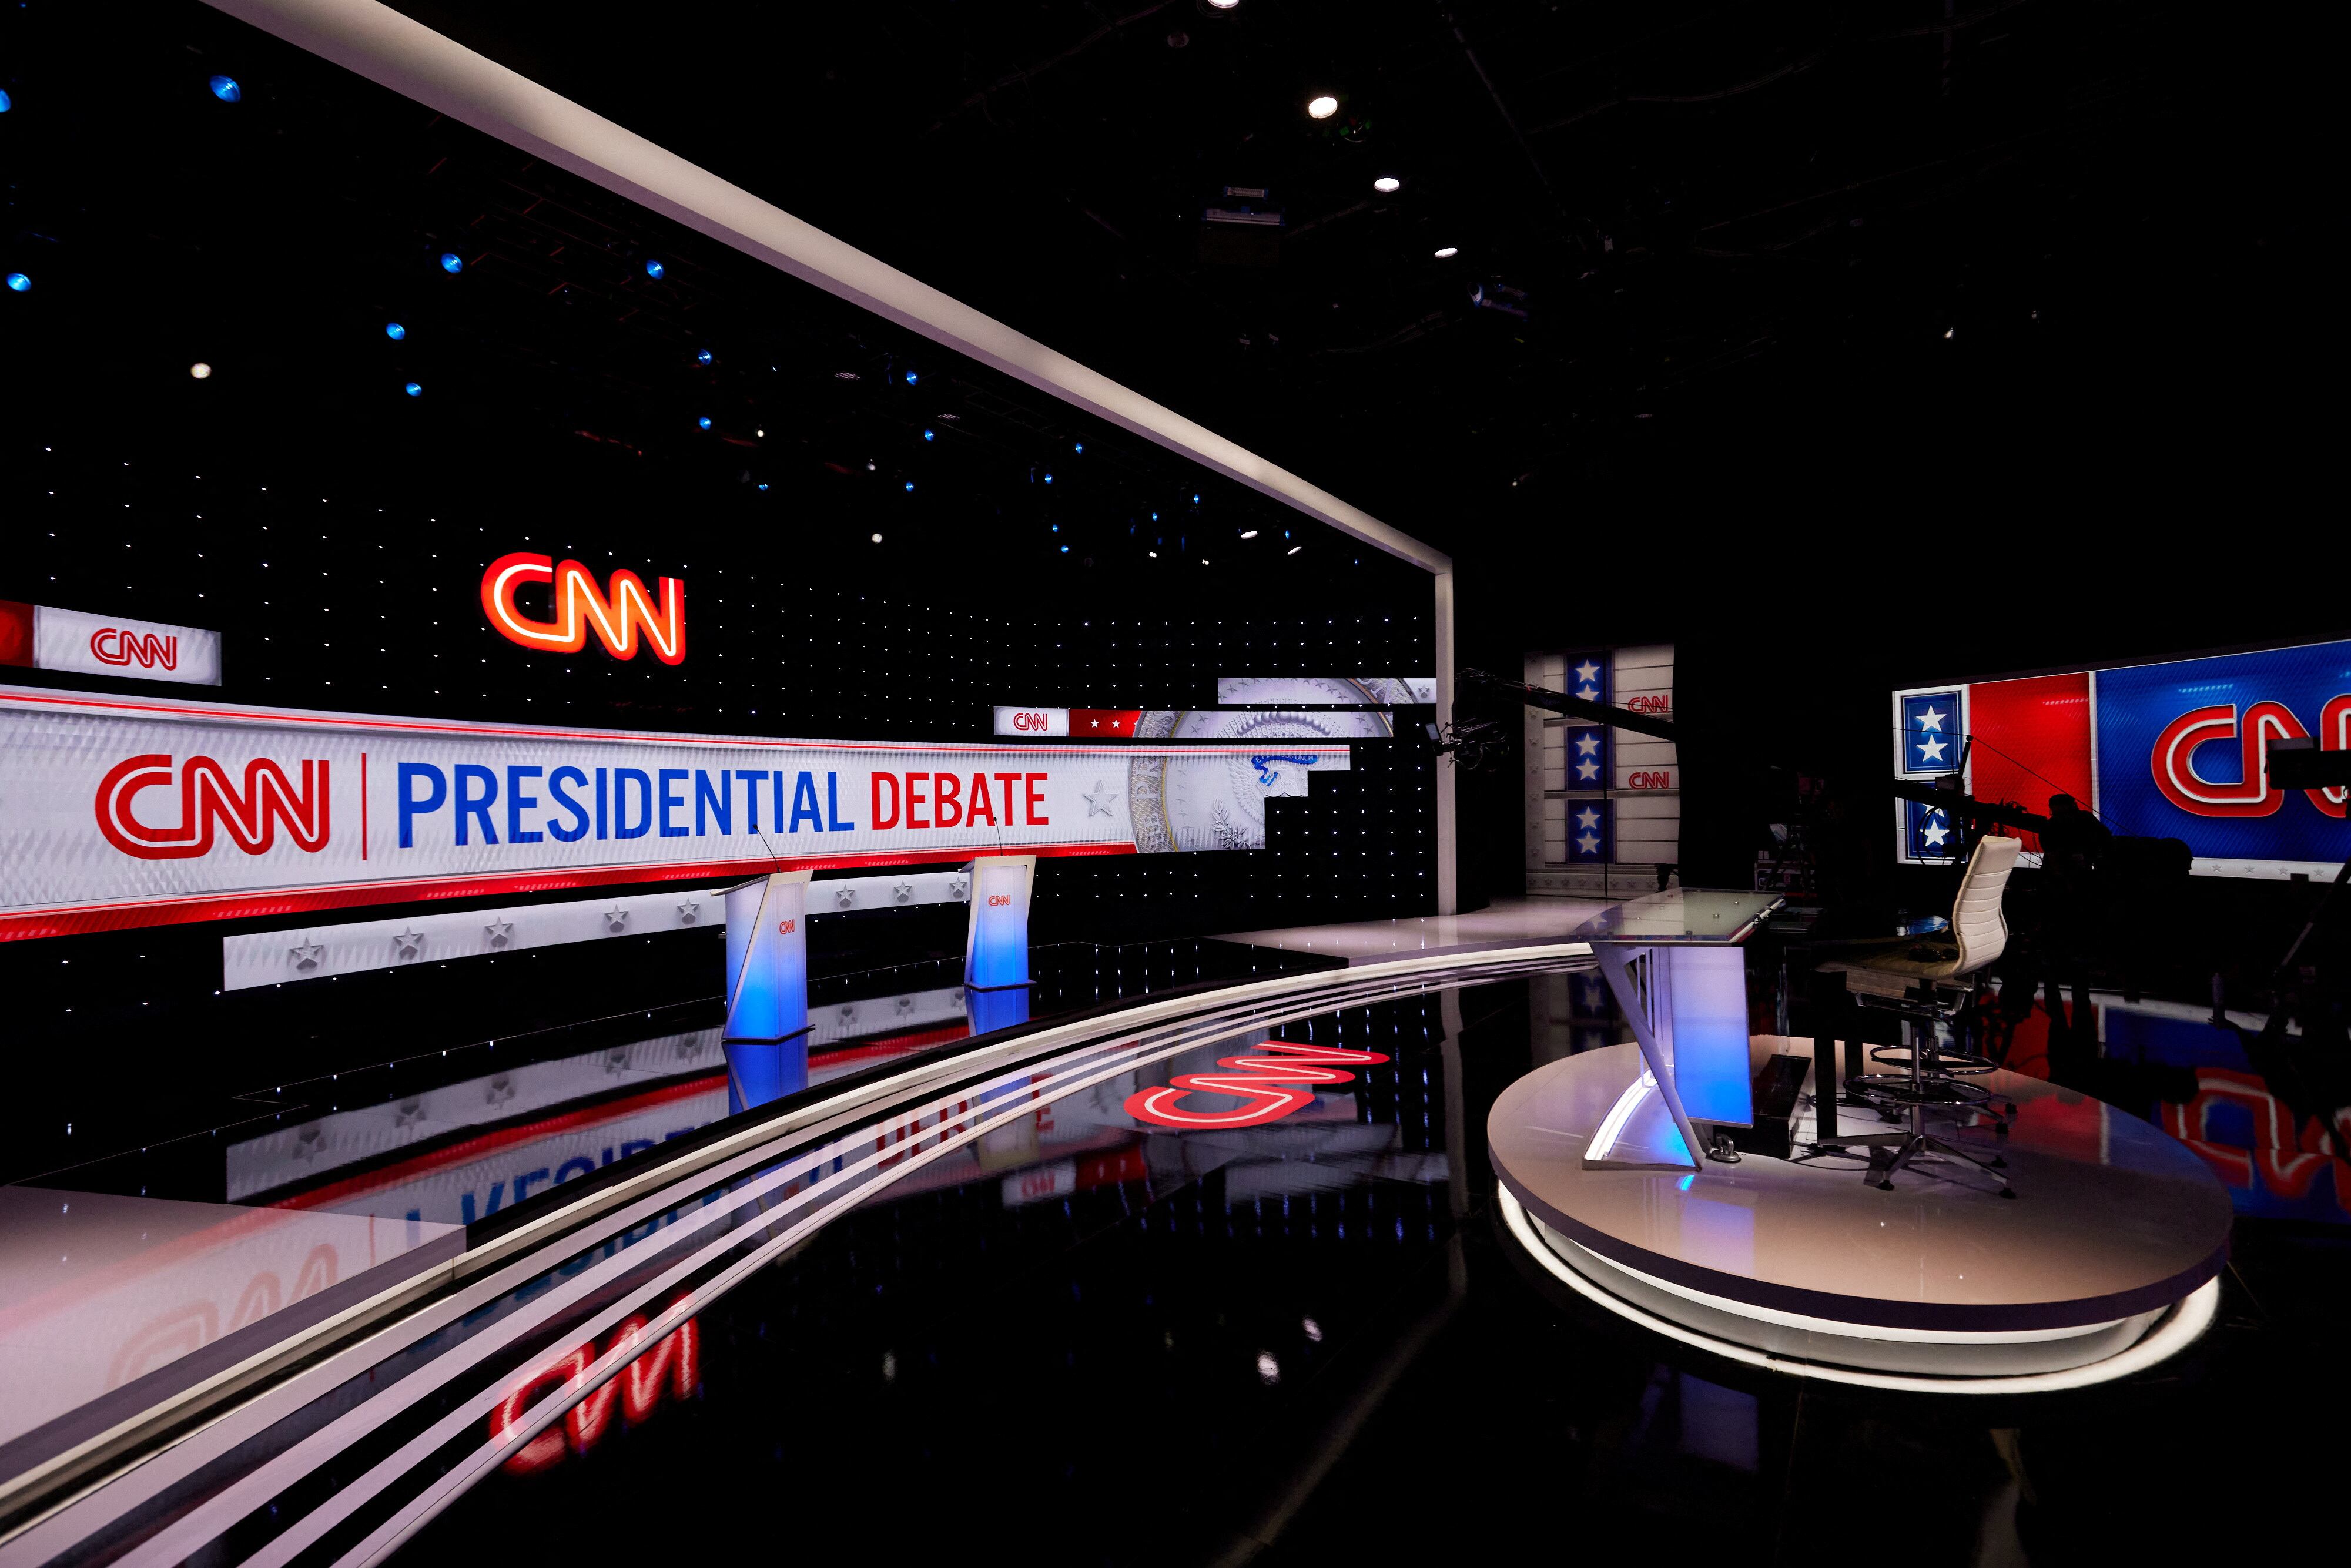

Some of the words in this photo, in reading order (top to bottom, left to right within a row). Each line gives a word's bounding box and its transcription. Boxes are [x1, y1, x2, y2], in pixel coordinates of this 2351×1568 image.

[480, 552, 686, 666] CNN
[90, 628, 177, 671] CNN
[1627, 695, 1669, 715] CNN
[1013, 713, 1048, 731] CNN
[1629, 771, 1669, 790] CNN
[95, 754, 330, 860] CNN
[398, 762, 855, 849] PRESIDENTIAL
[871, 772, 1049, 830] DEBATE
[988, 894, 1010, 906] CNN
[779, 919, 795, 934] CNN
[1123, 1040, 1391, 1129] CNN
